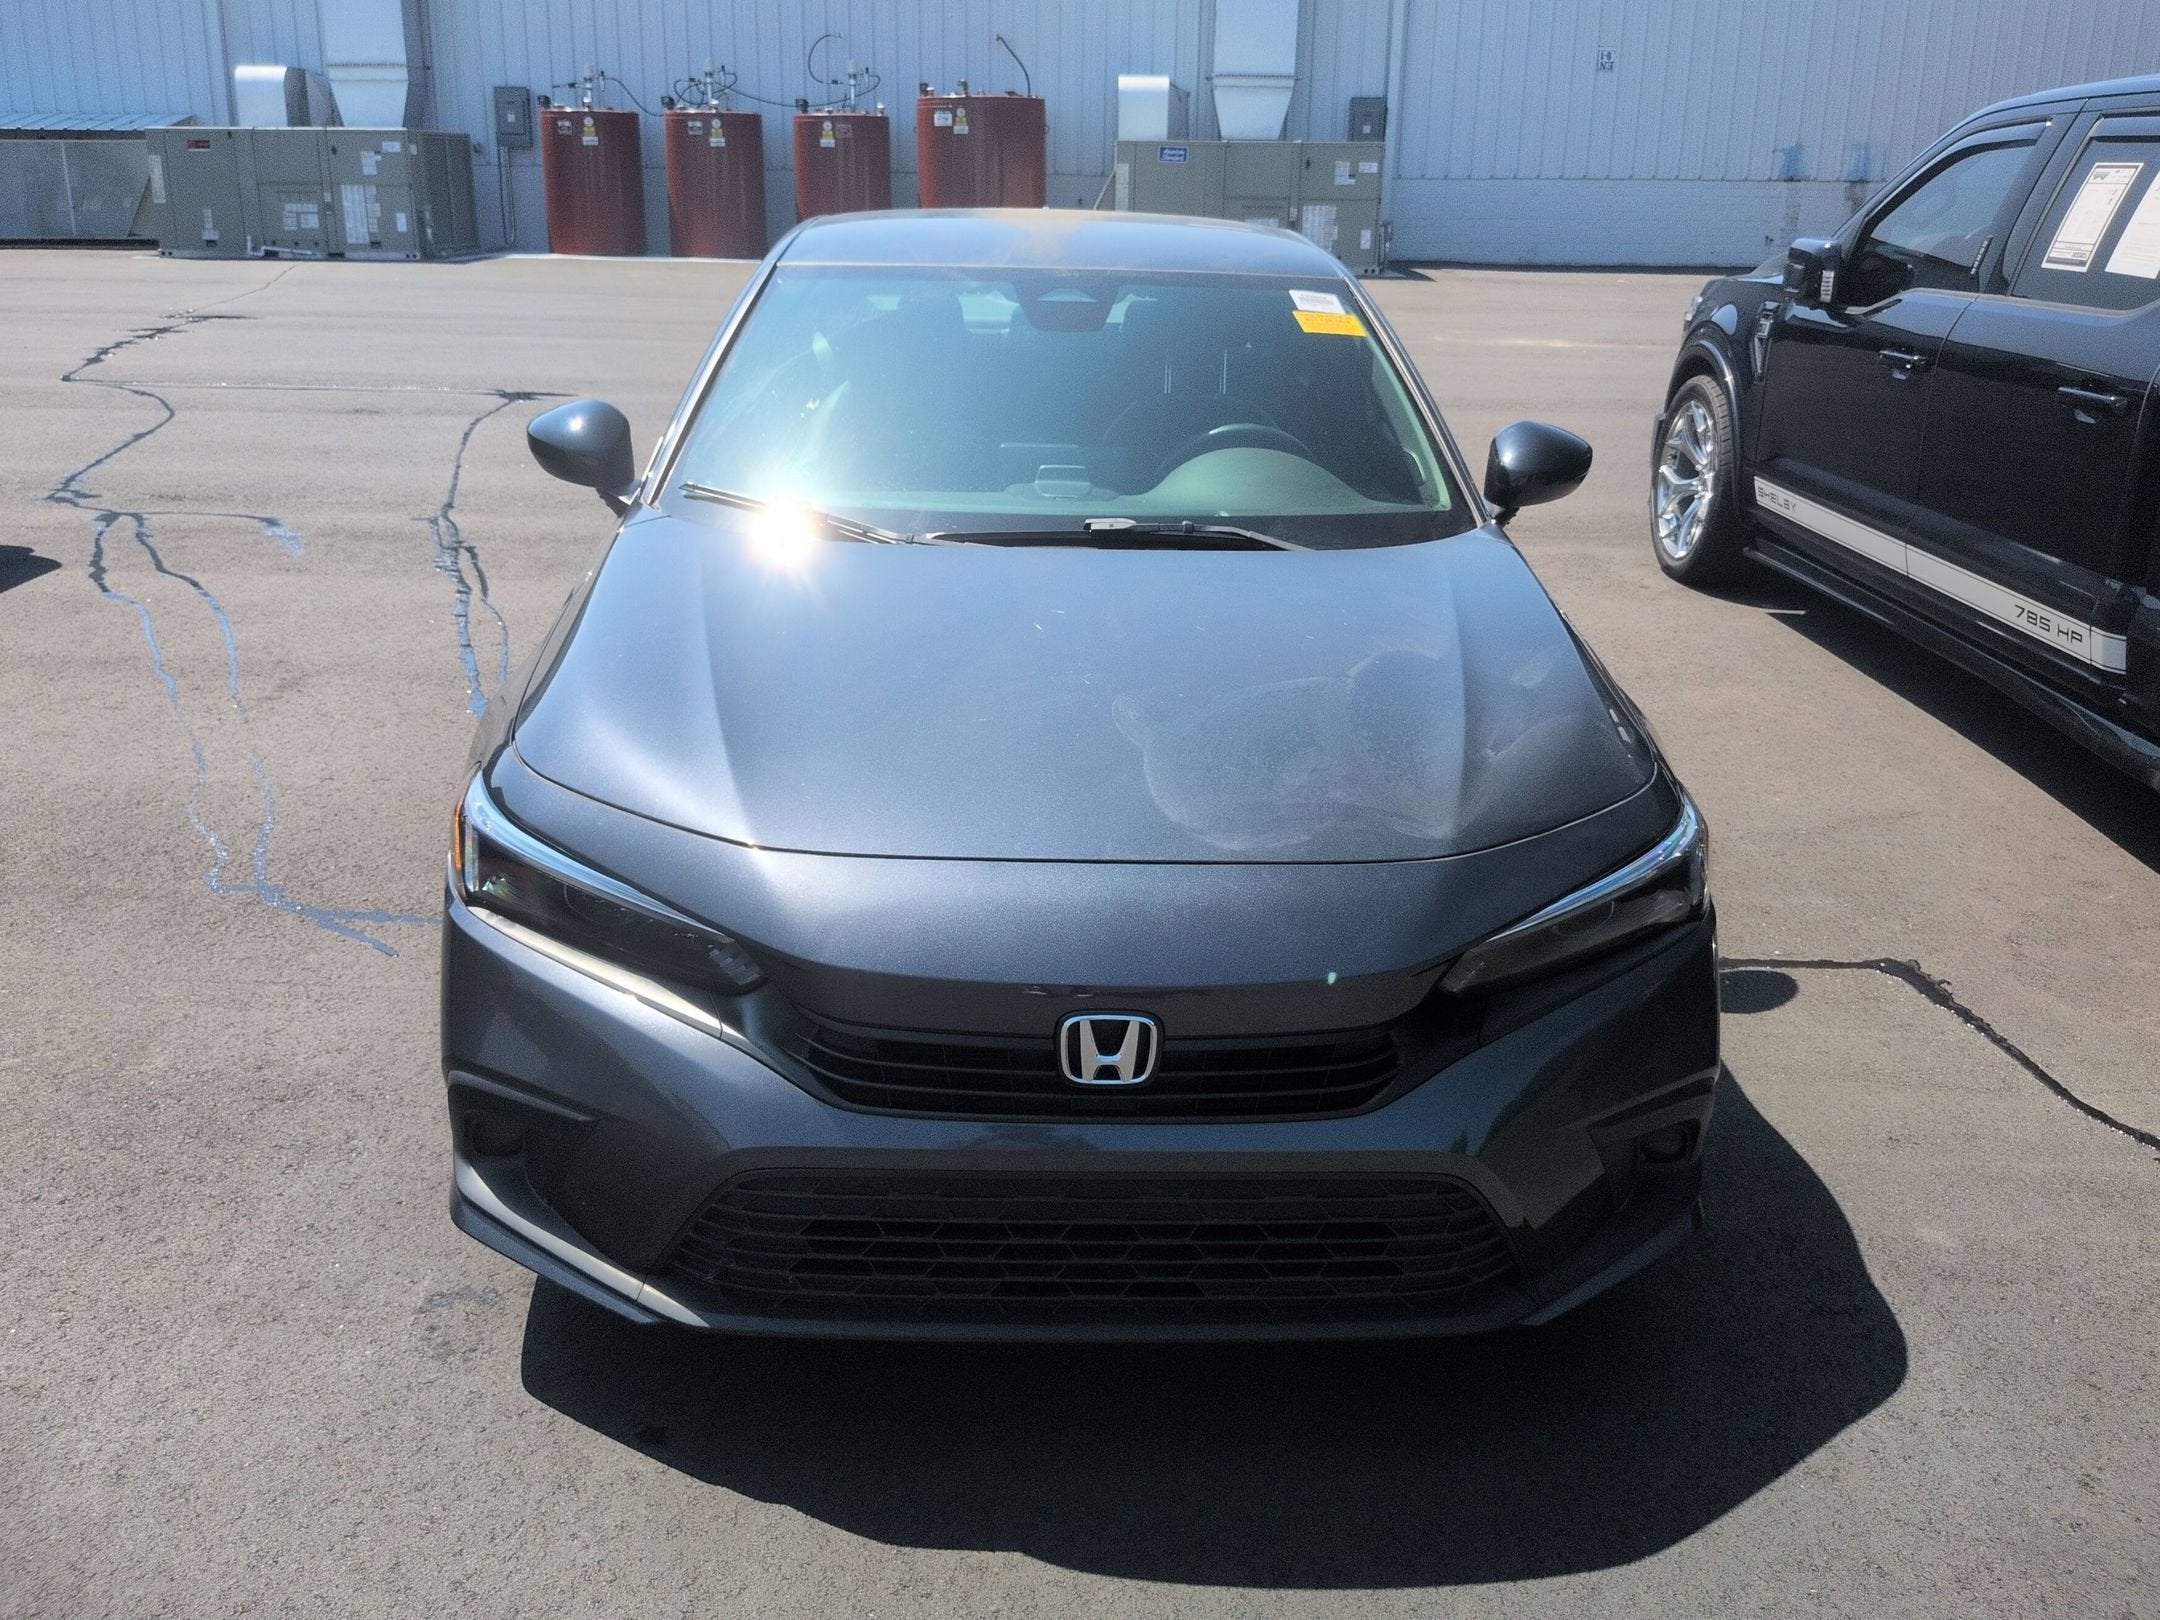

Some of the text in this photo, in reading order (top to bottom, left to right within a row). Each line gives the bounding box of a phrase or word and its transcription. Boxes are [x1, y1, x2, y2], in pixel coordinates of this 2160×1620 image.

[1757, 486, 1797, 513] SHELBY
[2014, 604, 2083, 644] 785 HP
